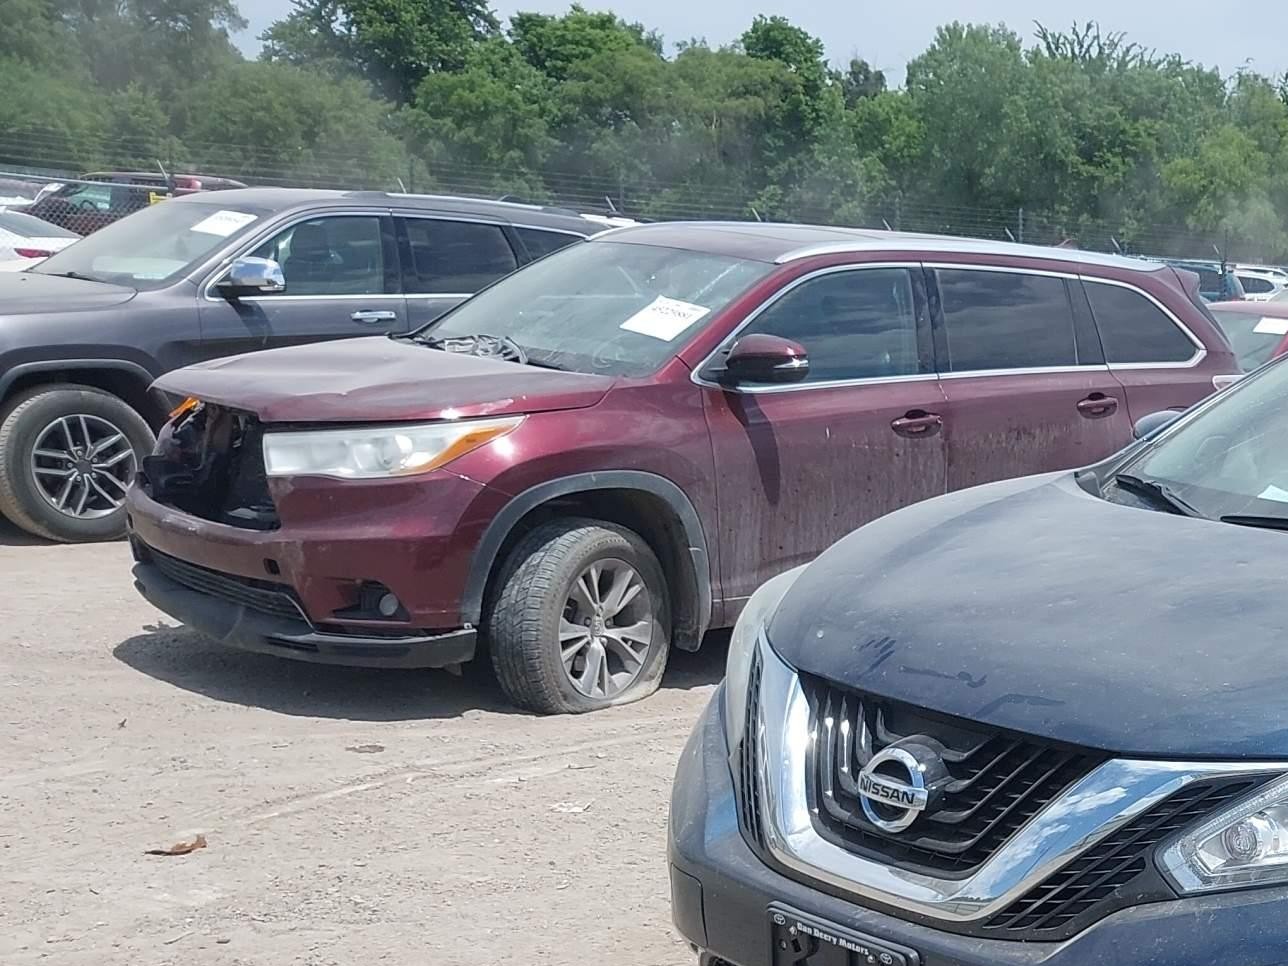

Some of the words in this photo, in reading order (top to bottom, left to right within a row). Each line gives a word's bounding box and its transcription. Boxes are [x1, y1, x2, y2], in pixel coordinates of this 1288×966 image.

[859, 776, 916, 805] NISSAN
[813, 927, 838, 945] Deery
[838, 938, 870, 956] Motors
